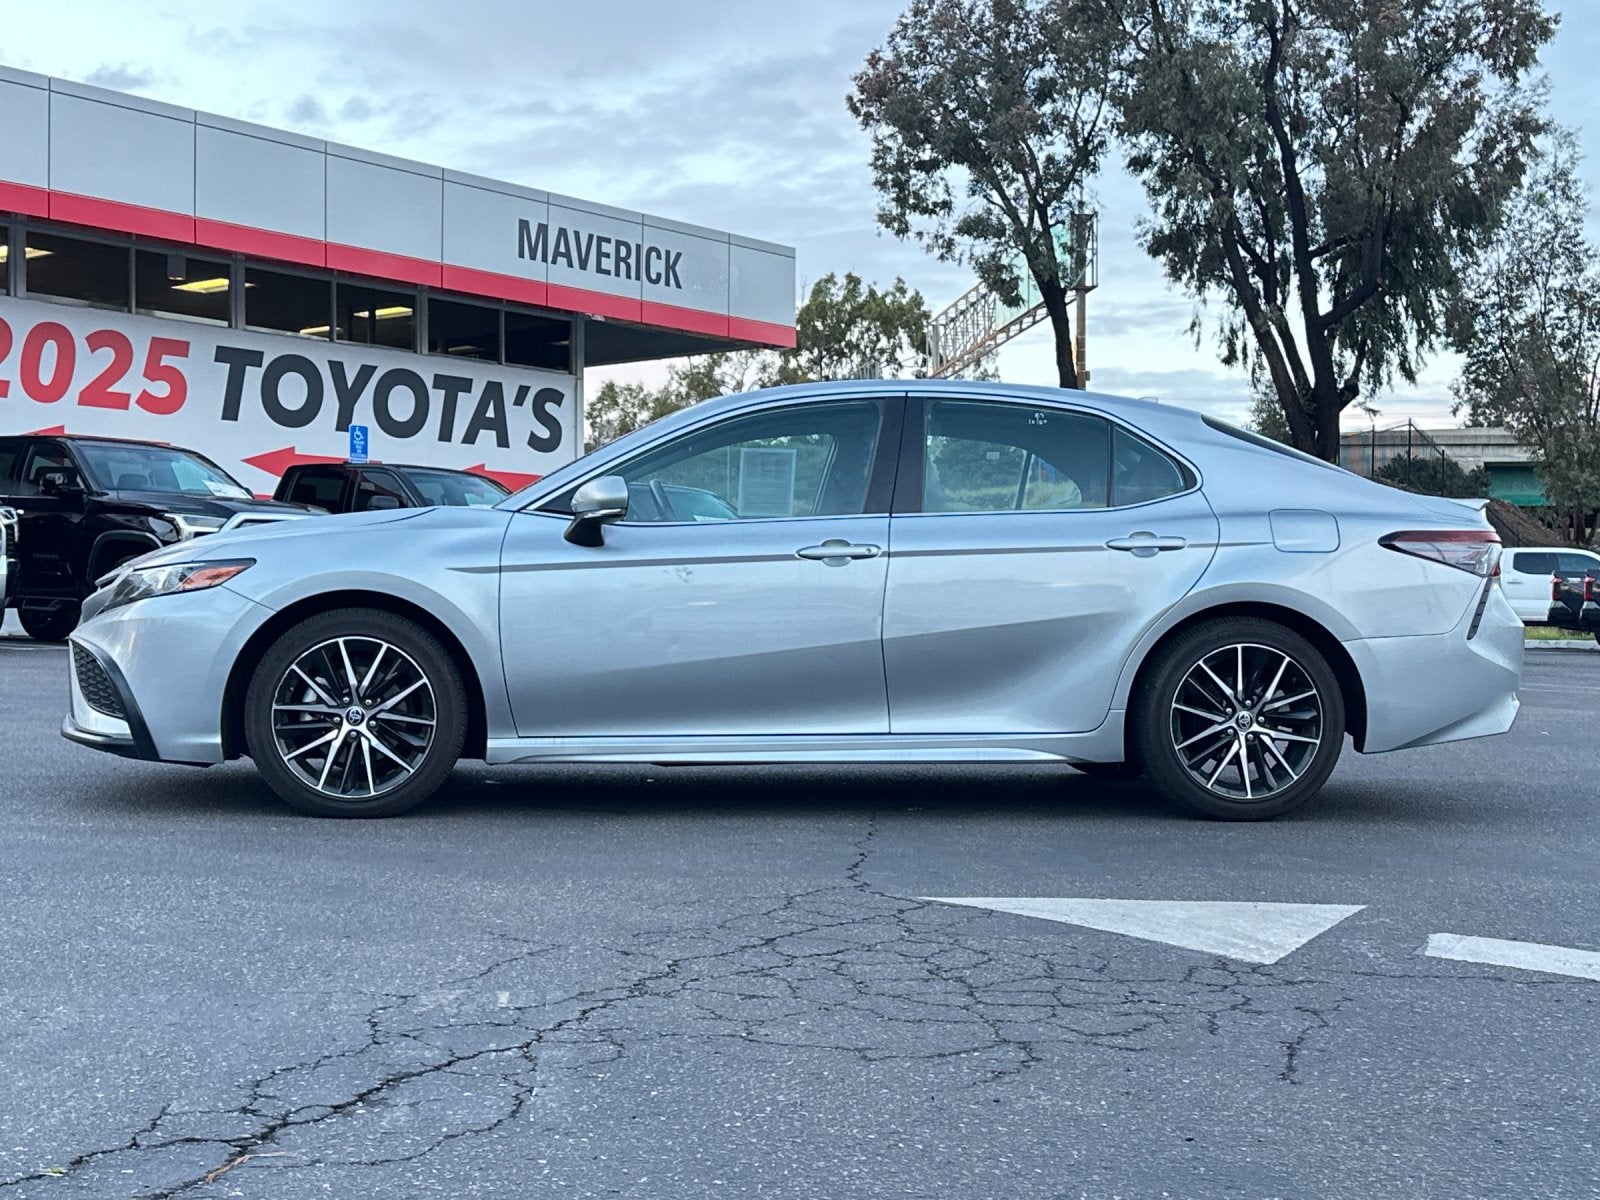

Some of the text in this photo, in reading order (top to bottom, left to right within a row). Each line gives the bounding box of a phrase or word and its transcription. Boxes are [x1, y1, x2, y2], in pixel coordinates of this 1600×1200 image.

[518, 218, 682, 289] MAVERICK
[0, 316, 565, 453] 025 TOYOTA'S
